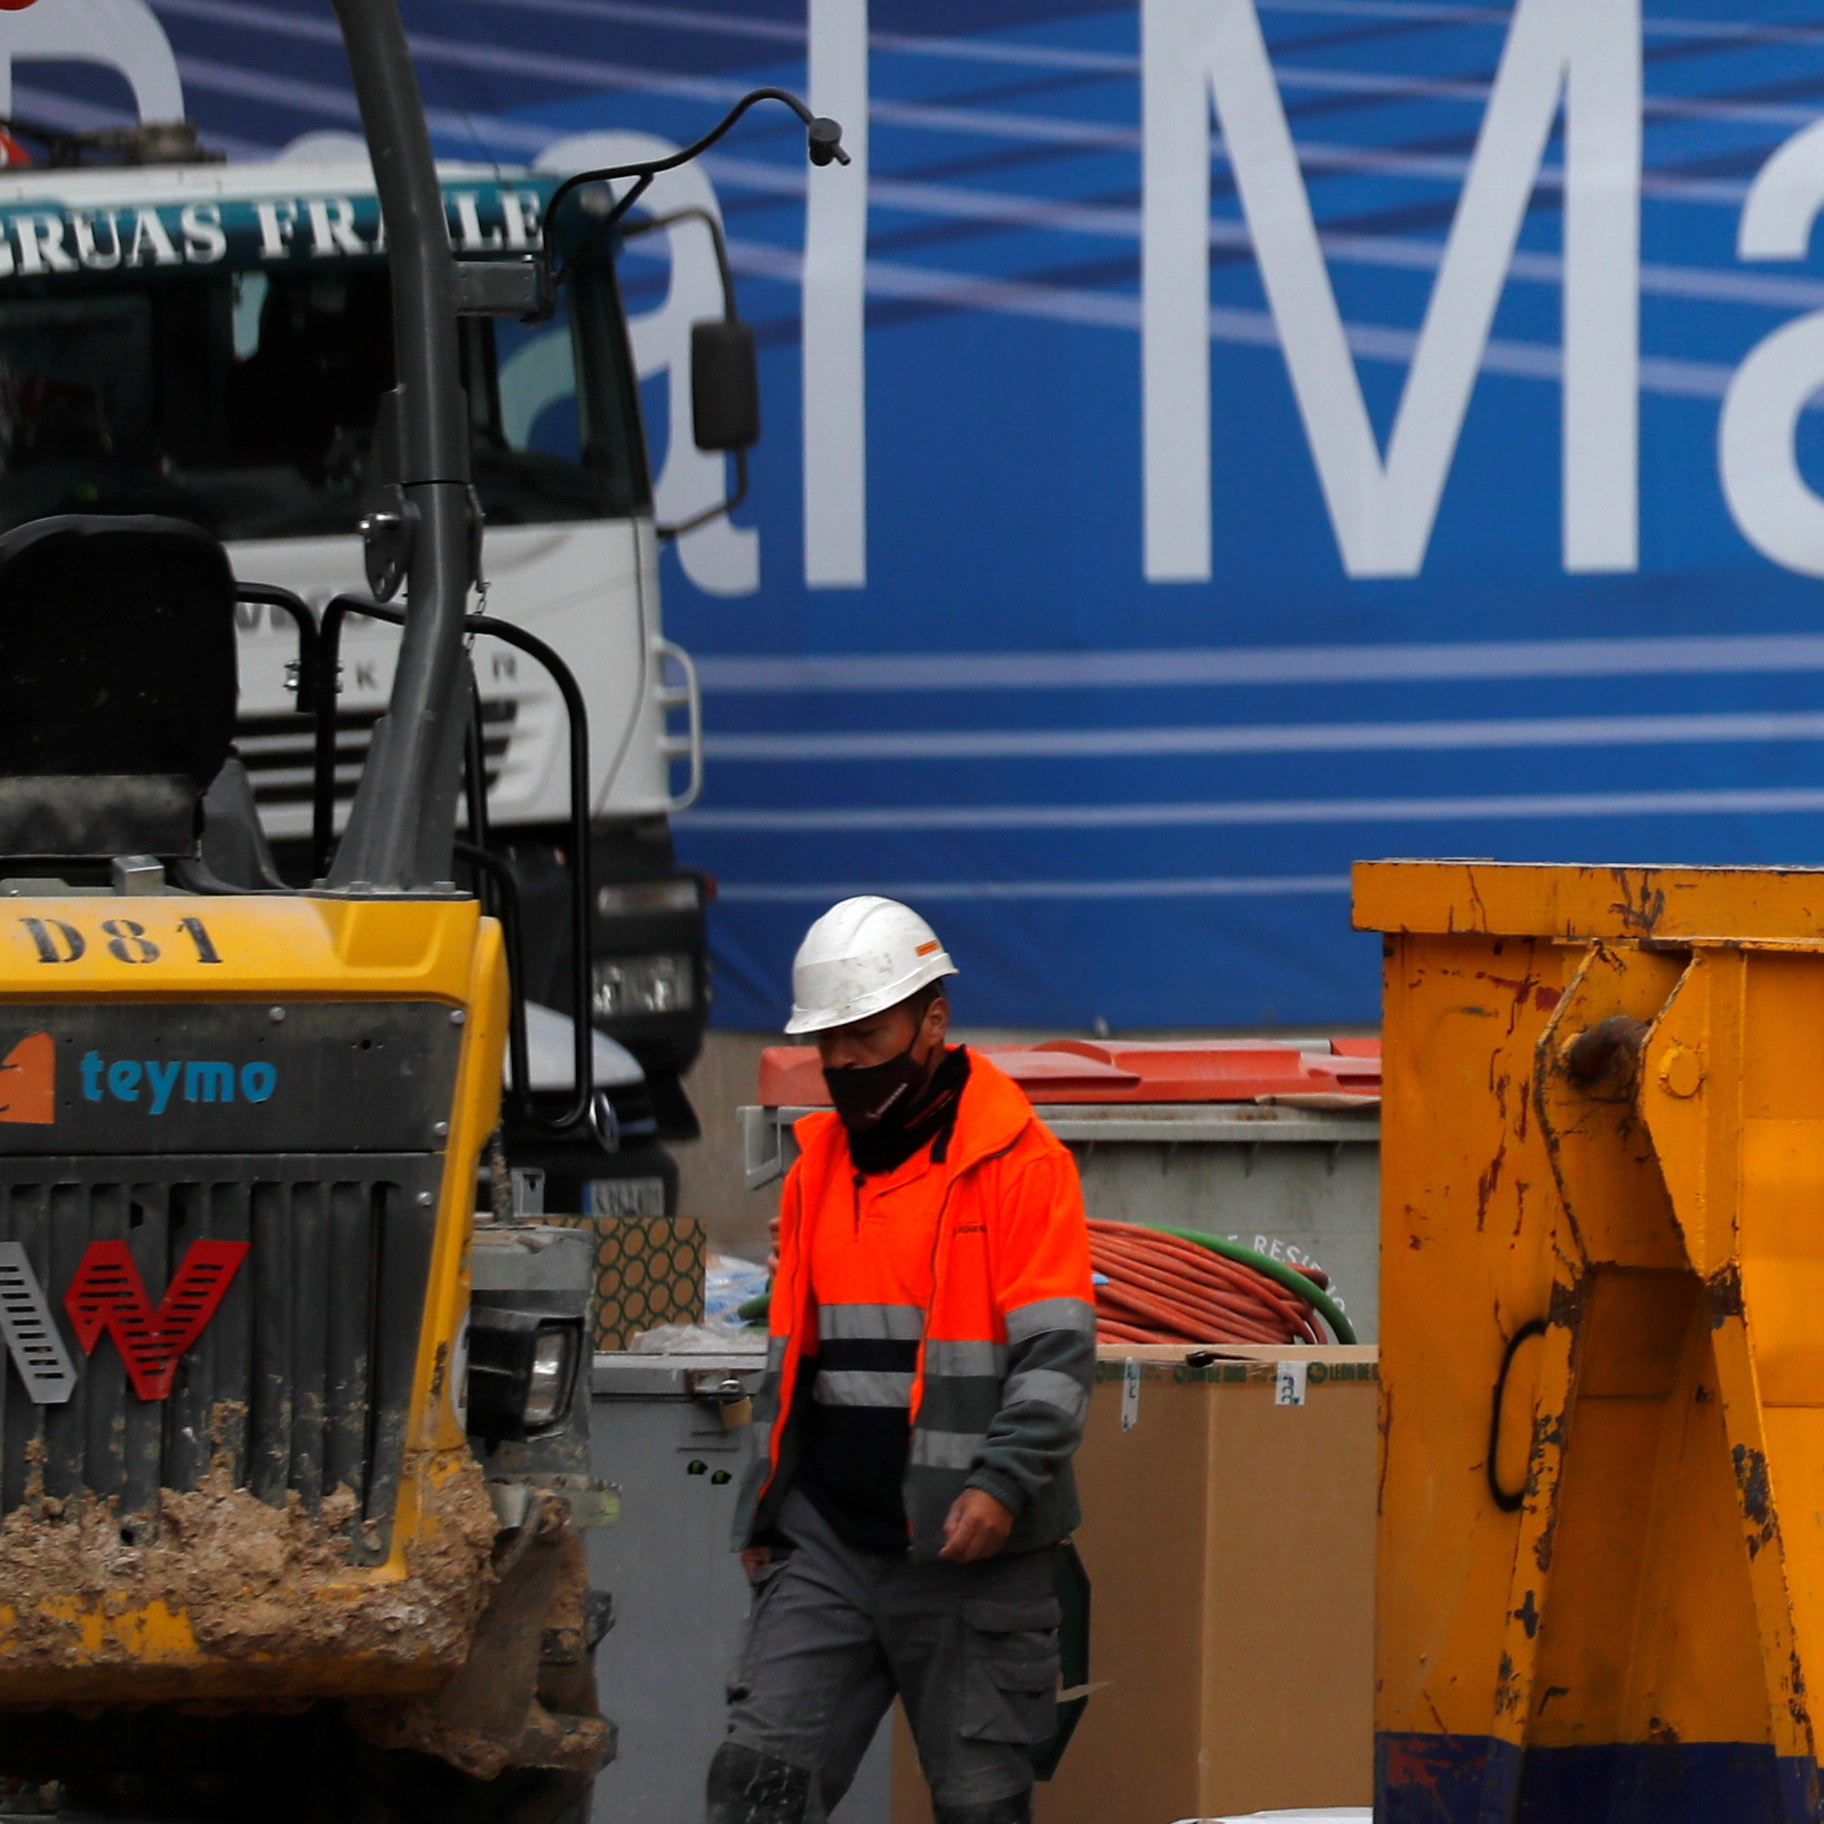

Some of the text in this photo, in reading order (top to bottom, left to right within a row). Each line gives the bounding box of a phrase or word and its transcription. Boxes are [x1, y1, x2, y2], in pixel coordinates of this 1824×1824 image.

[0, 188, 543, 276] RUAS FRLE
[19, 916, 224, 964] D81
[80, 1049, 277, 1115] teymo
